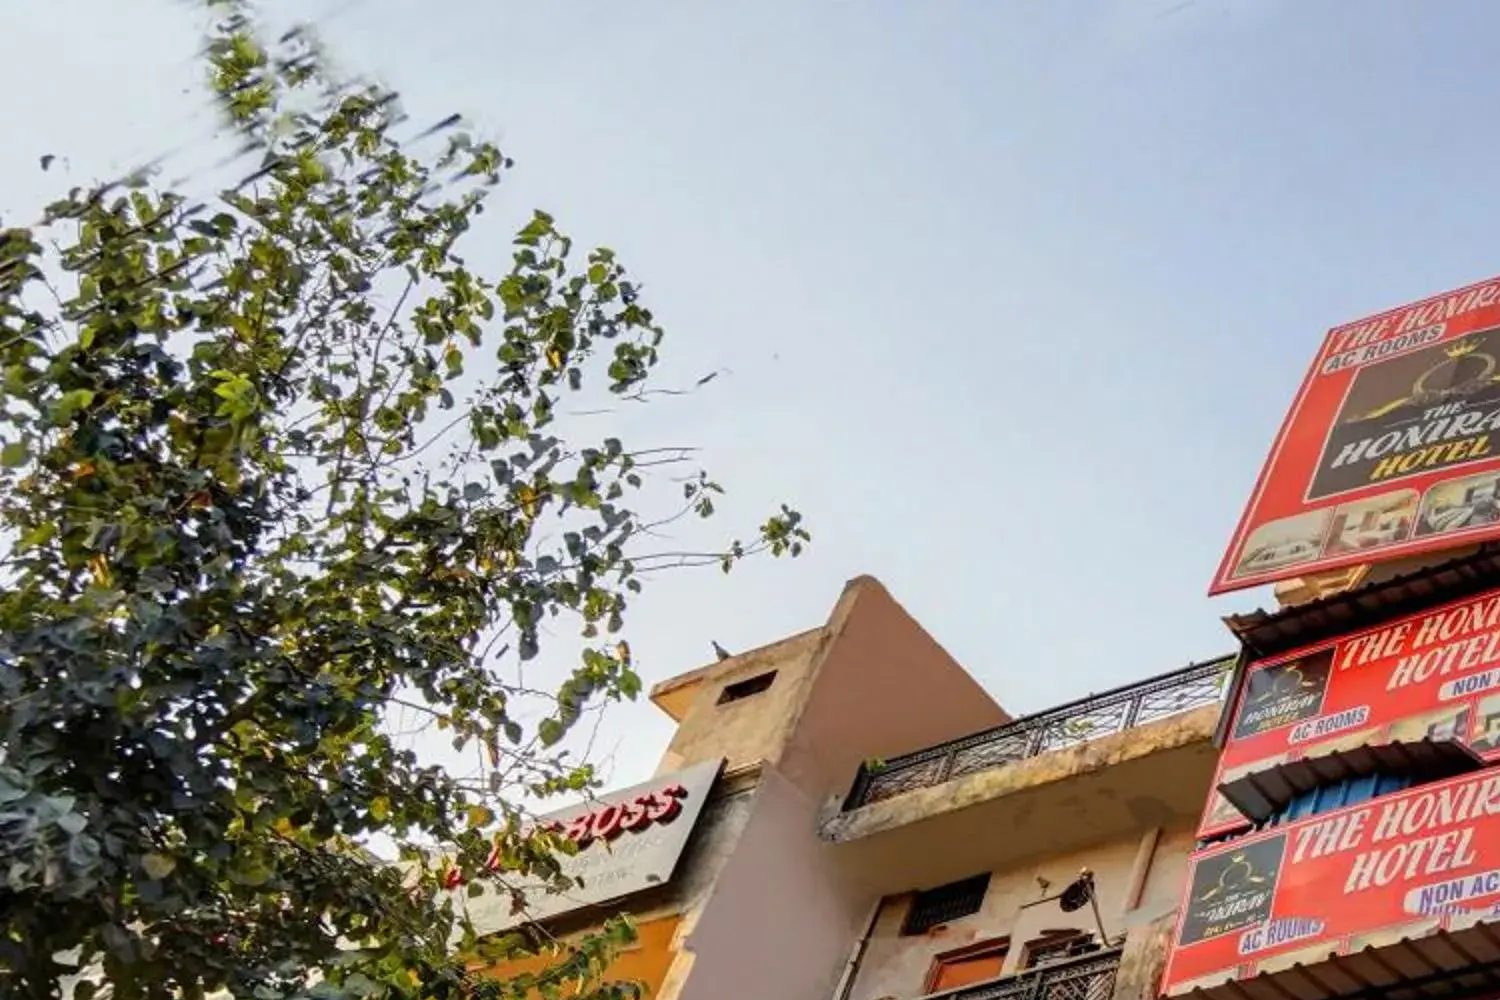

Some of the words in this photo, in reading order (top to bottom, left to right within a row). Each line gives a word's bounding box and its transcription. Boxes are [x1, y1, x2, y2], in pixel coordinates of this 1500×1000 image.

[1335, 314, 1397, 352] THE
[1327, 351, 1355, 370] AC
[1423, 401, 1466, 420] THE
[1370, 436, 1492, 480] HOTEL
[1339, 623, 1411, 670] THE
[1453, 672, 1497, 695] NON
[1293, 811, 1369, 864] THE
[1344, 828, 1475, 894] HOTEL
[1420, 880, 1464, 907] NON
[1470, 872, 1499, 892] AC
